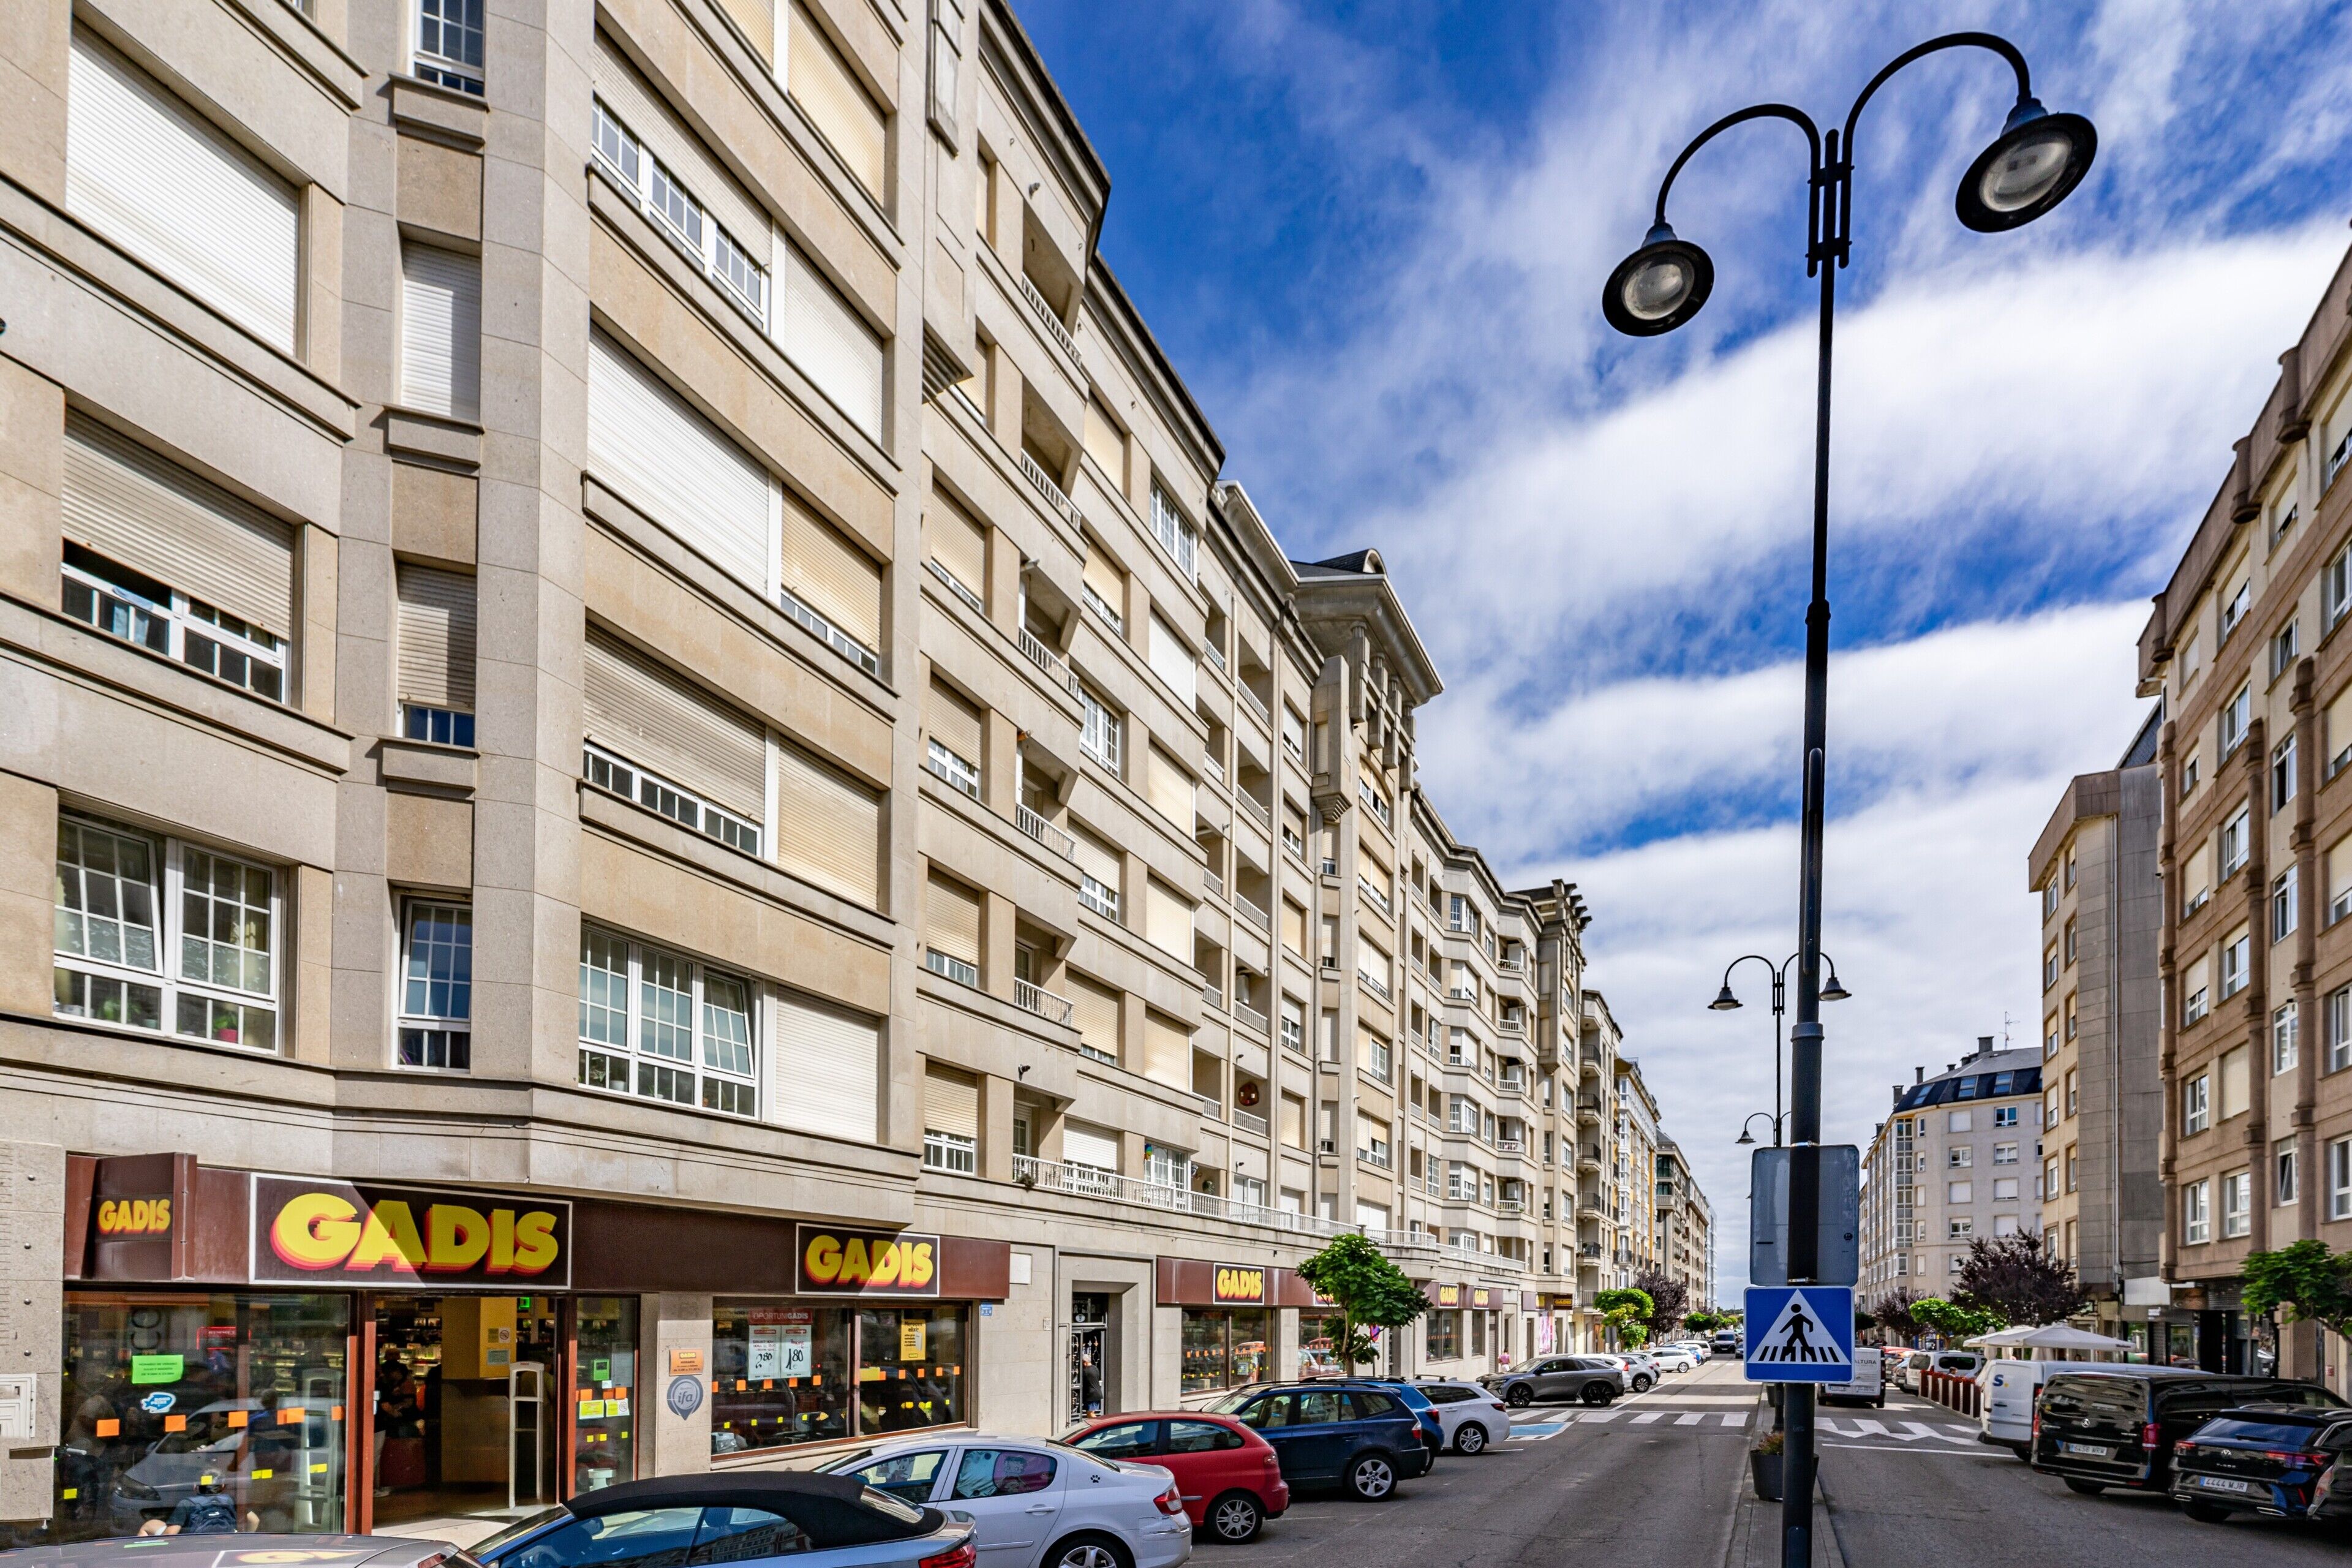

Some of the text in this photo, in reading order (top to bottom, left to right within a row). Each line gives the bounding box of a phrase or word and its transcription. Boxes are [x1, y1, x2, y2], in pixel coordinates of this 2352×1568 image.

[97, 1199, 171, 1235] GADIS
[270, 1193, 559, 1276] GADIS
[805, 1235, 933, 1289] GADIS
[1216, 1268, 1262, 1300] GADIS
[1440, 1286, 1458, 1305] GADIS
[1474, 1289, 1488, 1306] GADIS
[753, 1312, 809, 1321] OPORTUNIGADIS
[677, 1391, 693, 1404] ifa
